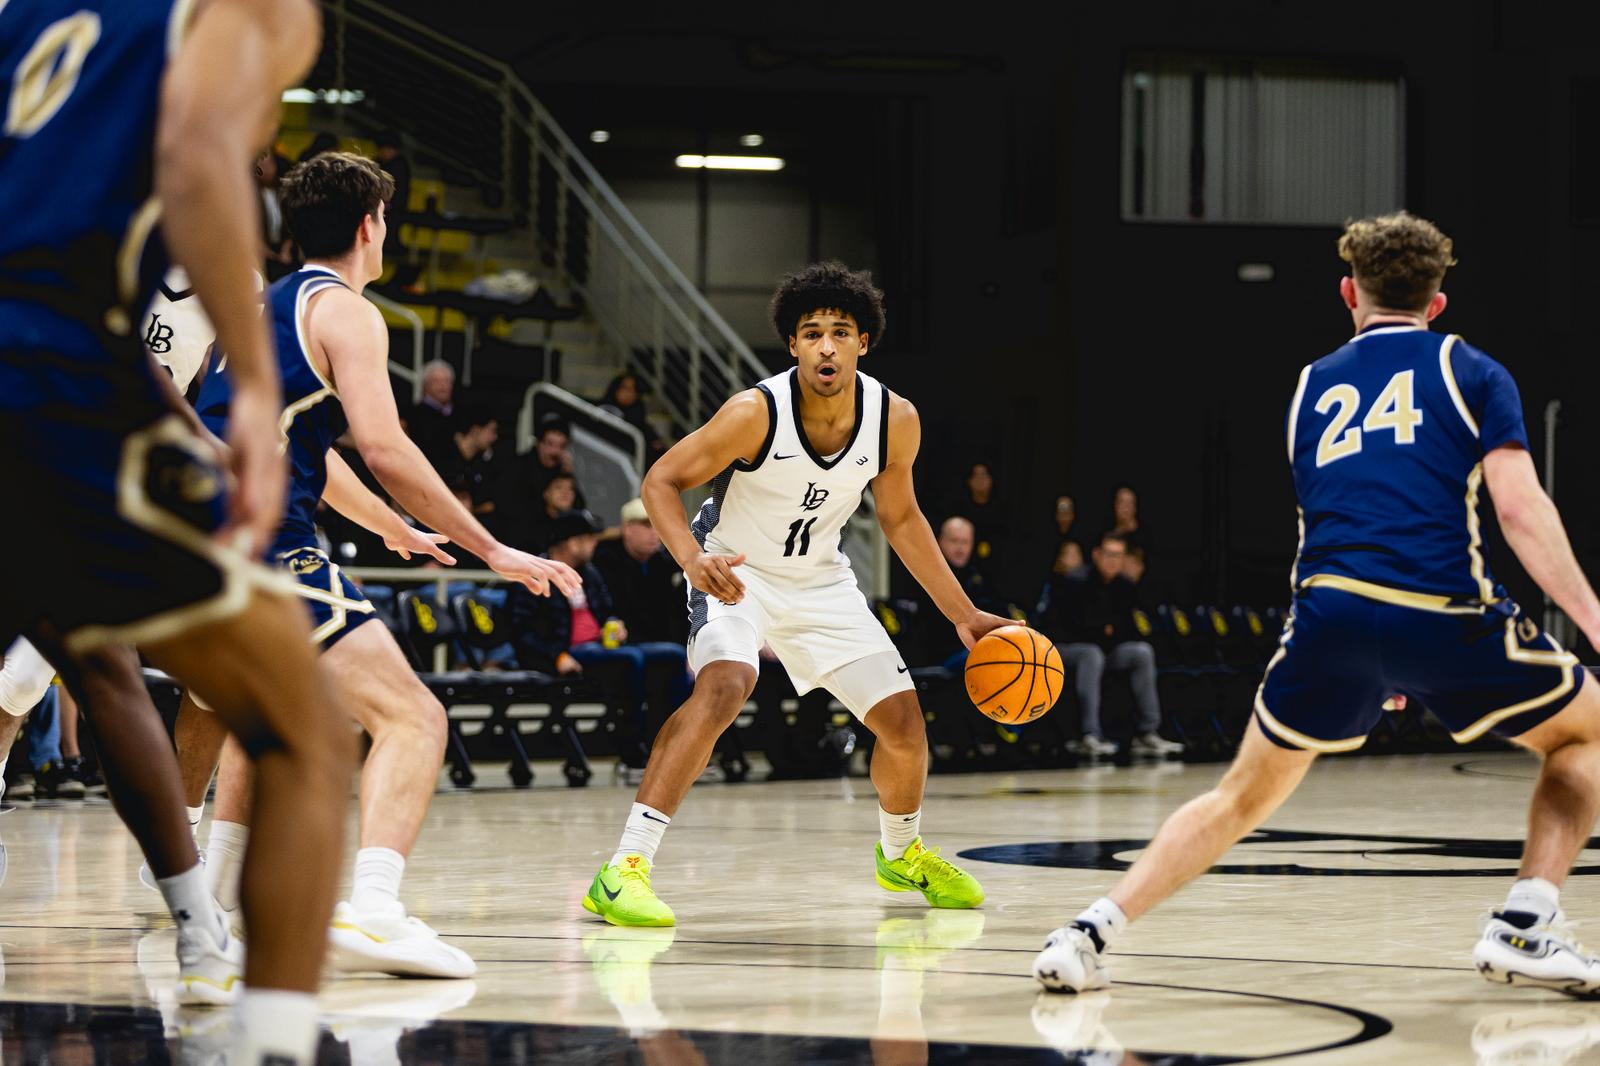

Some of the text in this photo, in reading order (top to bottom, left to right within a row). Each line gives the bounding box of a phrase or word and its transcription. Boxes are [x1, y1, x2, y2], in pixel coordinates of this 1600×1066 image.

[4, 9, 102, 139] 0
[1314, 369, 1423, 468] 24
[798, 482, 829, 512] LB
[783, 517, 818, 557] 11
